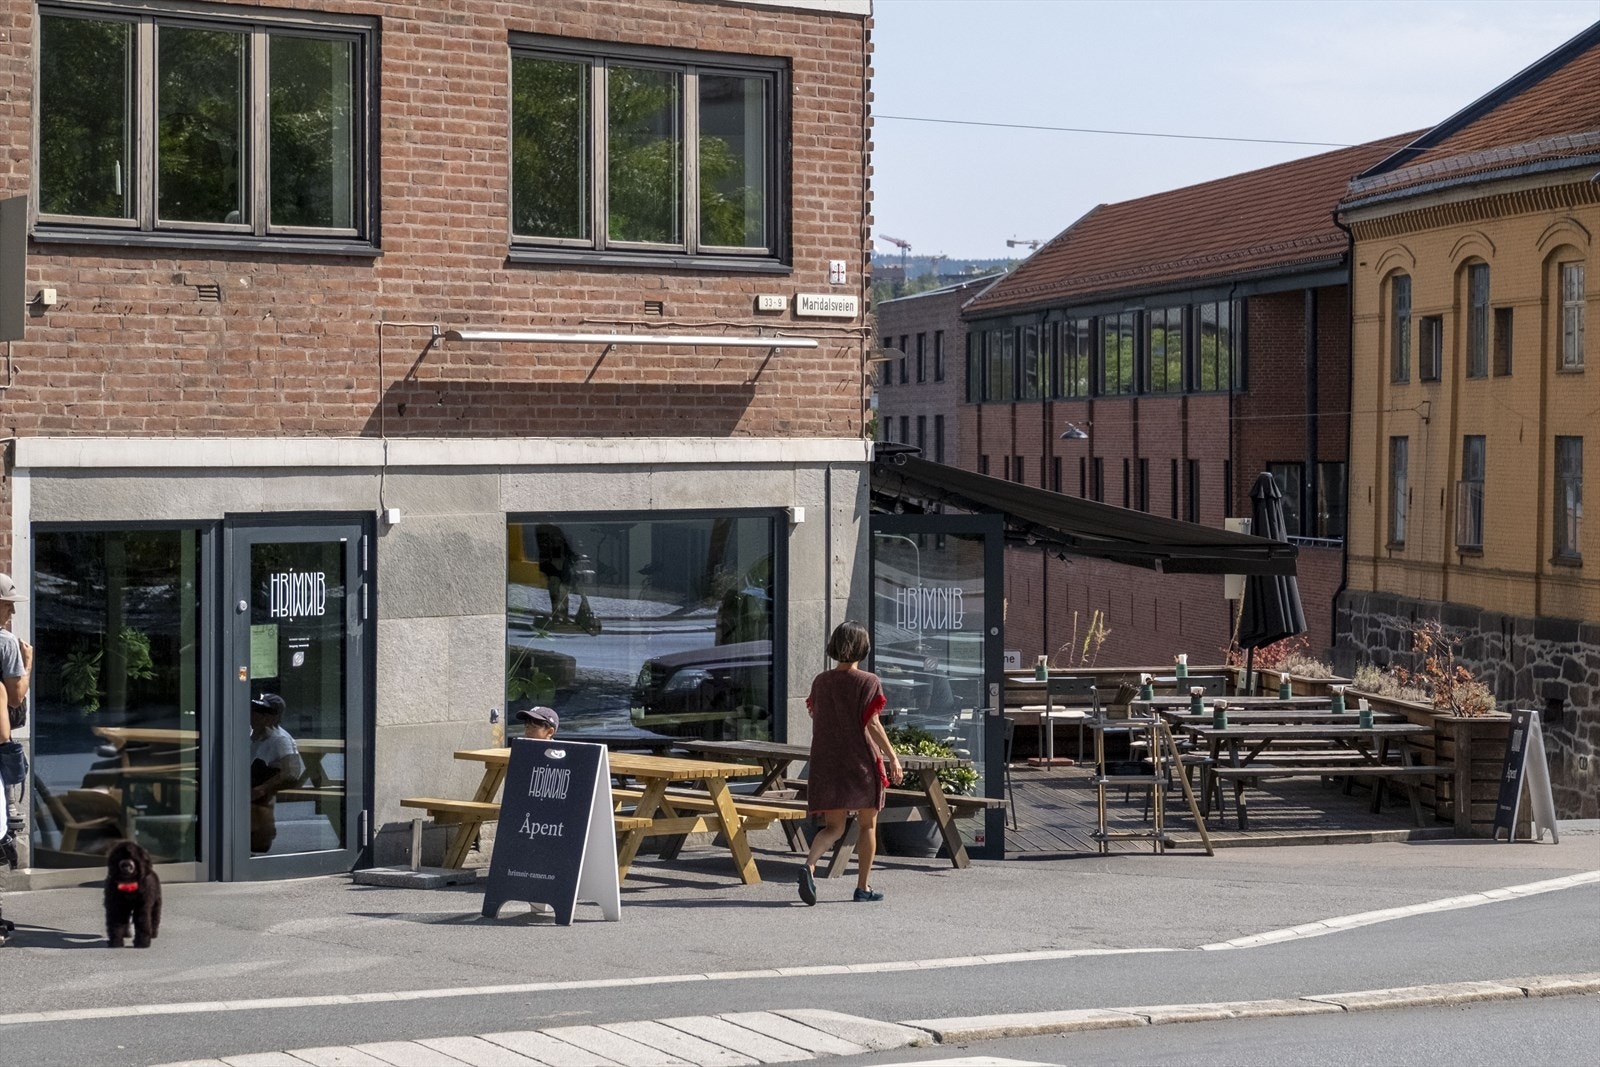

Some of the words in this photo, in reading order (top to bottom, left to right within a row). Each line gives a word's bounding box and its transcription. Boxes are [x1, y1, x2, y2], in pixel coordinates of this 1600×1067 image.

[802, 297, 854, 312] Maridalsveien
[518, 812, 564, 840] Åpent
[507, 869, 556, 881] hrimnir-ramen.no
